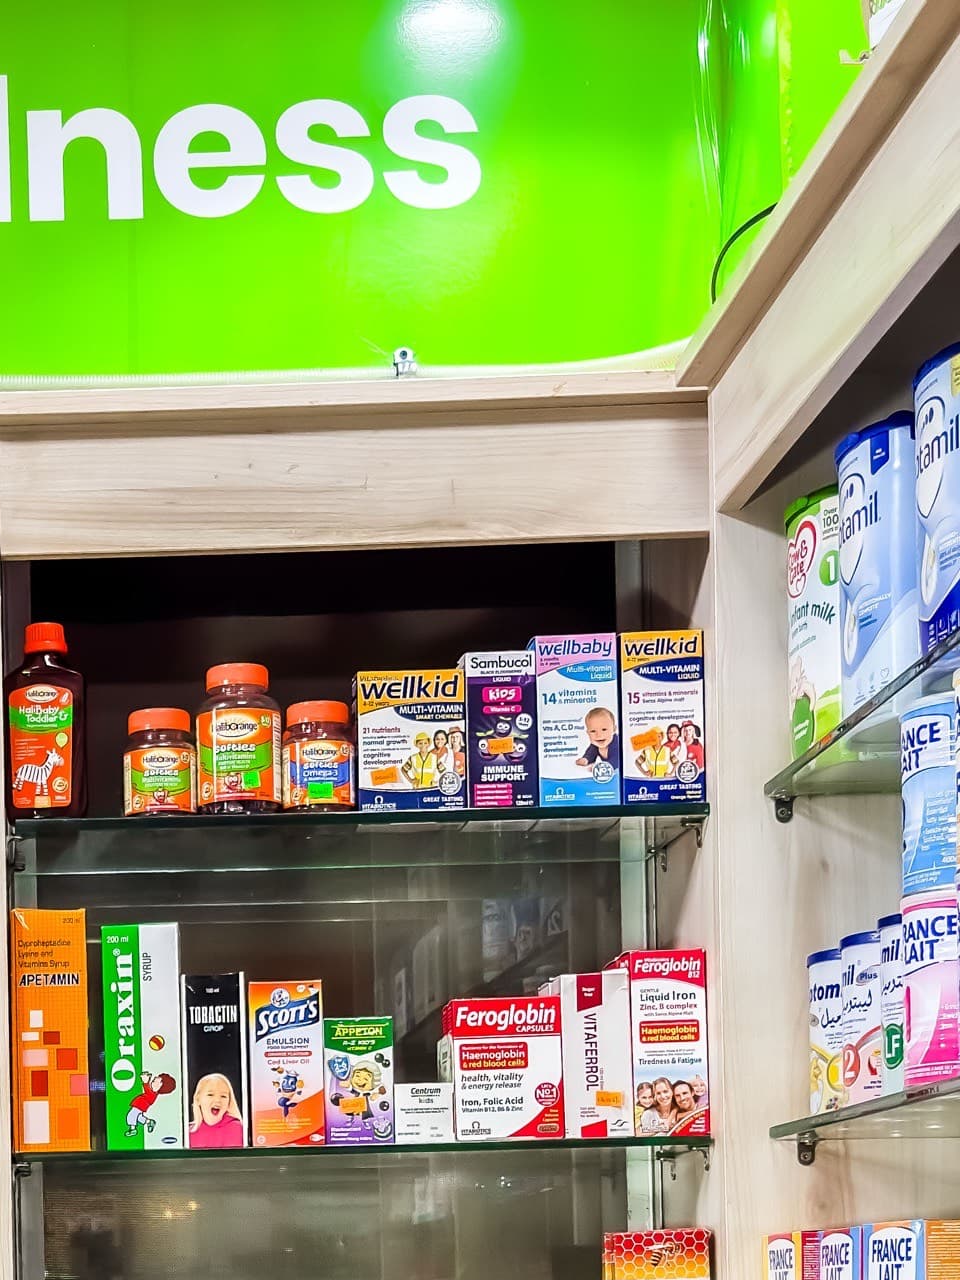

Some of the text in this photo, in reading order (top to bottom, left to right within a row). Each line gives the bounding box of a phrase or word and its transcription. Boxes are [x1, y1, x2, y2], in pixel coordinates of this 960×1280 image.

[823, 515, 839, 528] 100
[827, 556, 835, 581] 1
[811, 602, 835, 624] milk
[539, 639, 612, 657] wellbaby
[624, 637, 697, 658] wellkid
[471, 656, 532, 669] Sambucol
[590, 672, 612, 680] Liquid
[639, 665, 700, 674] MULTI-VITAMIN
[361, 675, 458, 699] wellkid
[559, 688, 597, 697] vitamins
[488, 688, 516, 701] kids
[542, 693, 556, 705] 14
[627, 693, 640, 704] 15
[399, 704, 463, 714] MULTI-VITAMIN
[481, 773, 527, 782] SUPPORT
[143, 952, 152, 981] SYRUP
[634, 958, 700, 975] Feroglobin
[19, 974, 79, 986] APETAMIN
[860, 972, 877, 980] Plus
[640, 990, 696, 1002] Liquid Iron
[190, 1004, 237, 1024] TOBACTIN
[257, 999, 318, 1037] SCOTT'S
[456, 1005, 555, 1032] Feroglobin
[111, 953, 135, 1091] Oraxin
[516, 1025, 553, 1033] CAPSULES
[642, 1026, 698, 1035] Haemoglobin
[266, 1037, 310, 1046] EMULSION
[886, 1035, 900, 1058] LF
[462, 1050, 525, 1060] Haemoglobin
[584, 1013, 598, 1091] VITAFERROL
[845, 1050, 855, 1078] 2
[461, 1073, 524, 1084] health, vitality
[411, 1087, 441, 1095] Centrum
[822, 1243, 850, 1267] FRANCE
[872, 1238, 912, 1263] FRANCE
